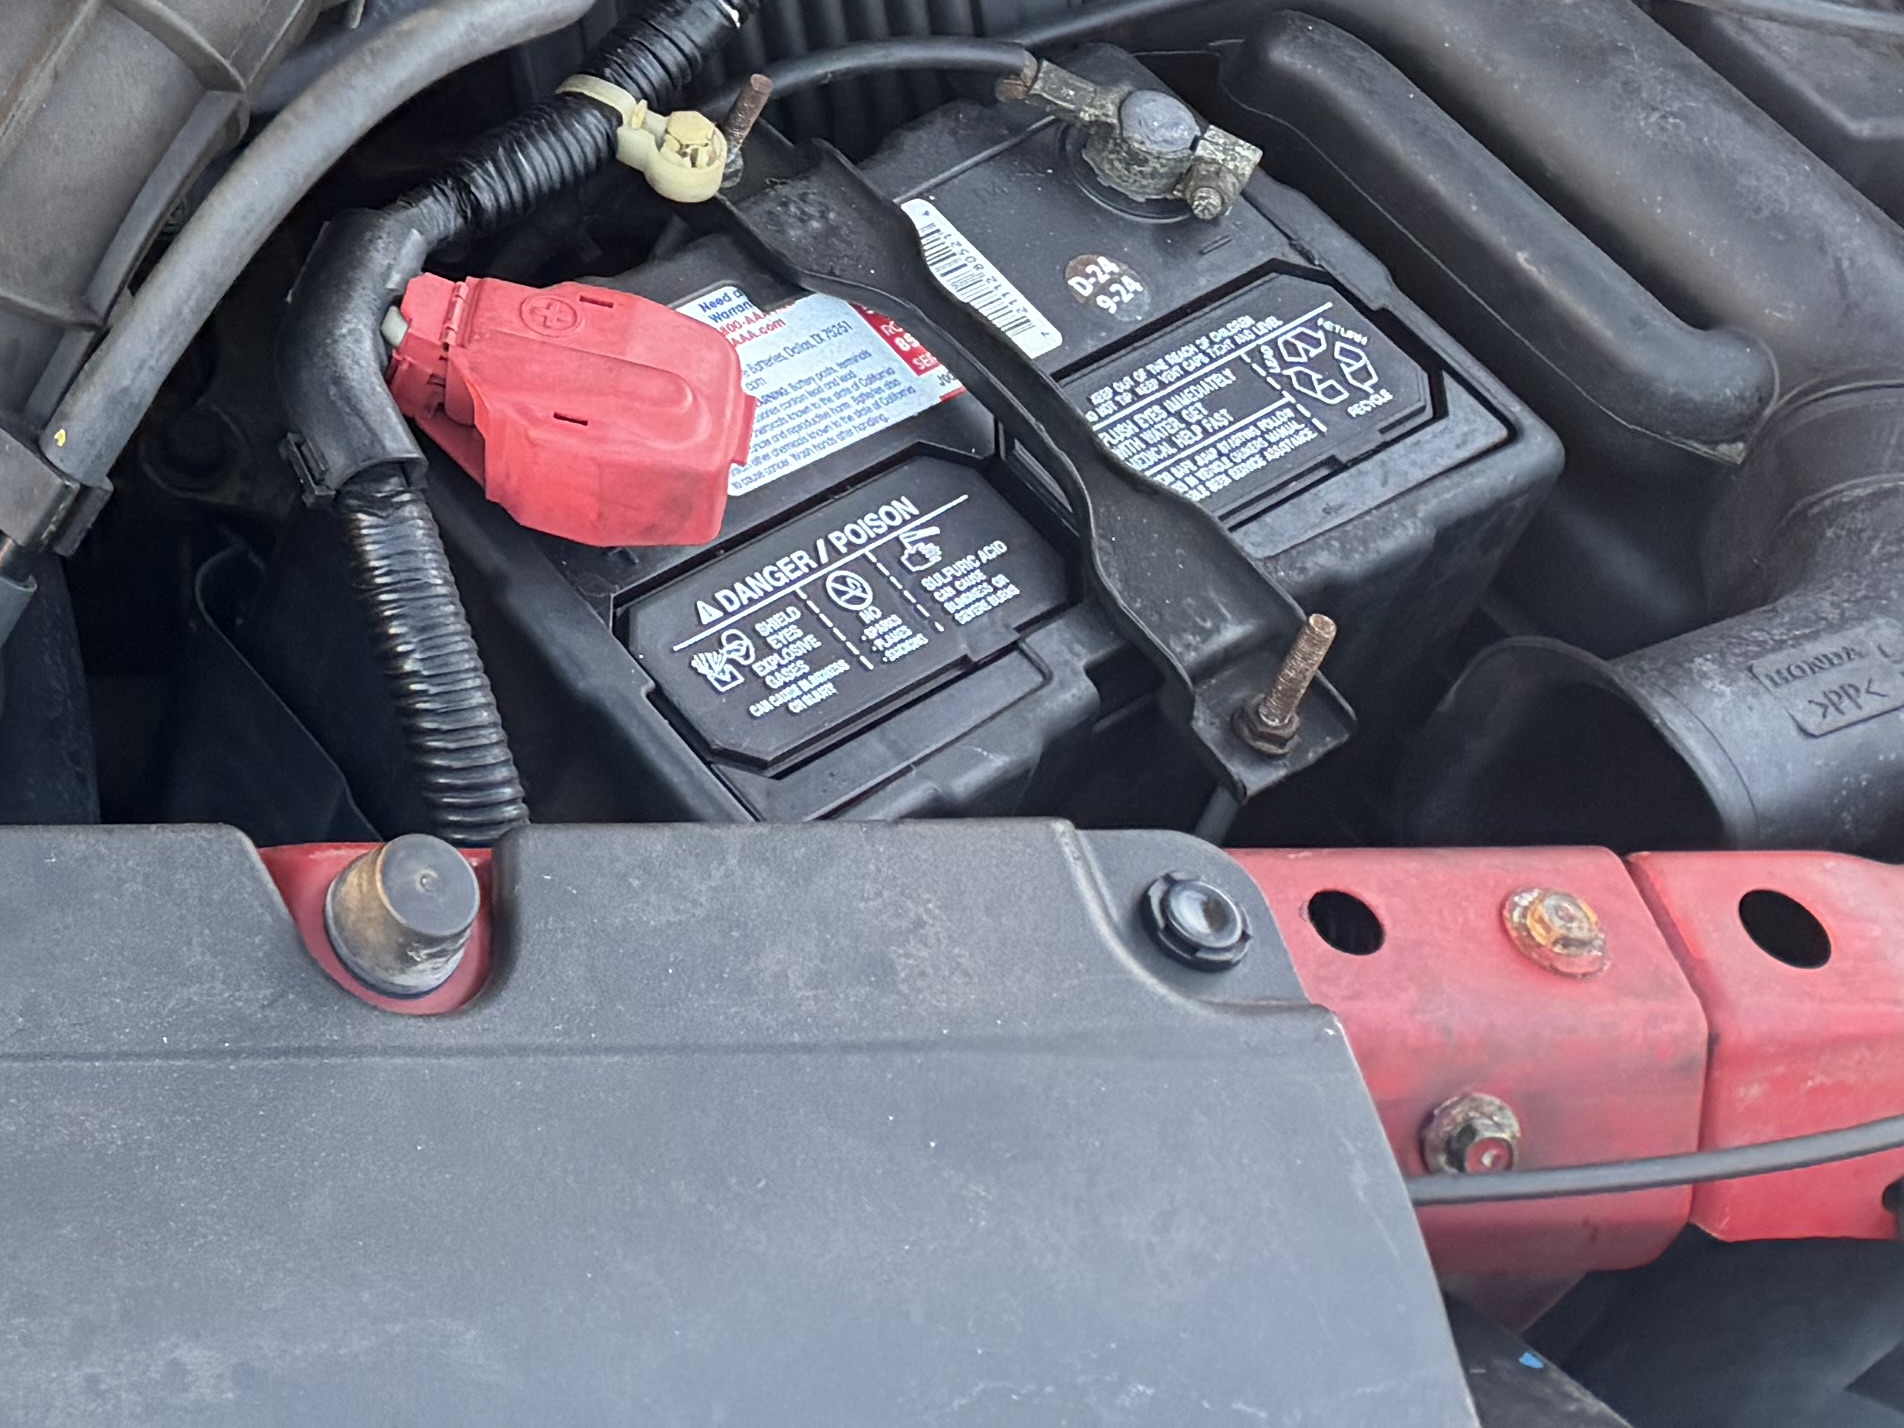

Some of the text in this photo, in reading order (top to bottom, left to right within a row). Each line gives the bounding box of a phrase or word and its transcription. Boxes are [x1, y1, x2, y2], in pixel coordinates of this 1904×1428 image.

[1068, 255, 1120, 296] D-24
[1095, 274, 1144, 314] 9-24
[697, 291, 733, 314] Need
[821, 320, 855, 341] 75251
[1316, 317, 1369, 346] RETURN
[1095, 399, 1119, 418] NOT
[1134, 377, 1160, 396] KEEP
[1157, 364, 1185, 385] VENT
[1181, 352, 1211, 372] CAPS
[1233, 328, 1257, 345] AND
[1112, 376, 1135, 393] OUT
[1145, 357, 1170, 376] THE
[1164, 343, 1199, 367] REACH
[1133, 404, 1169, 430] EYES
[1162, 367, 1238, 415] IMMEDIATELY
[1180, 401, 1209, 424] GET
[1346, 388, 1394, 419] RECYCLE
[1171, 423, 1205, 449] HELP
[1201, 407, 1235, 433] FAST
[714, 549, 819, 614] DANGER
[827, 495, 920, 555] POISON
[921, 540, 1008, 592] SULFURIC ACID
[933, 568, 987, 602] CAN CAUSE
[754, 605, 802, 637] SHIELD
[858, 605, 882, 624] NO
[752, 634, 823, 677] EXPLOSIVE
[765, 624, 804, 650] EYES
[764, 659, 811, 689] GASES
[1764, 645, 1868, 688] HONDA
